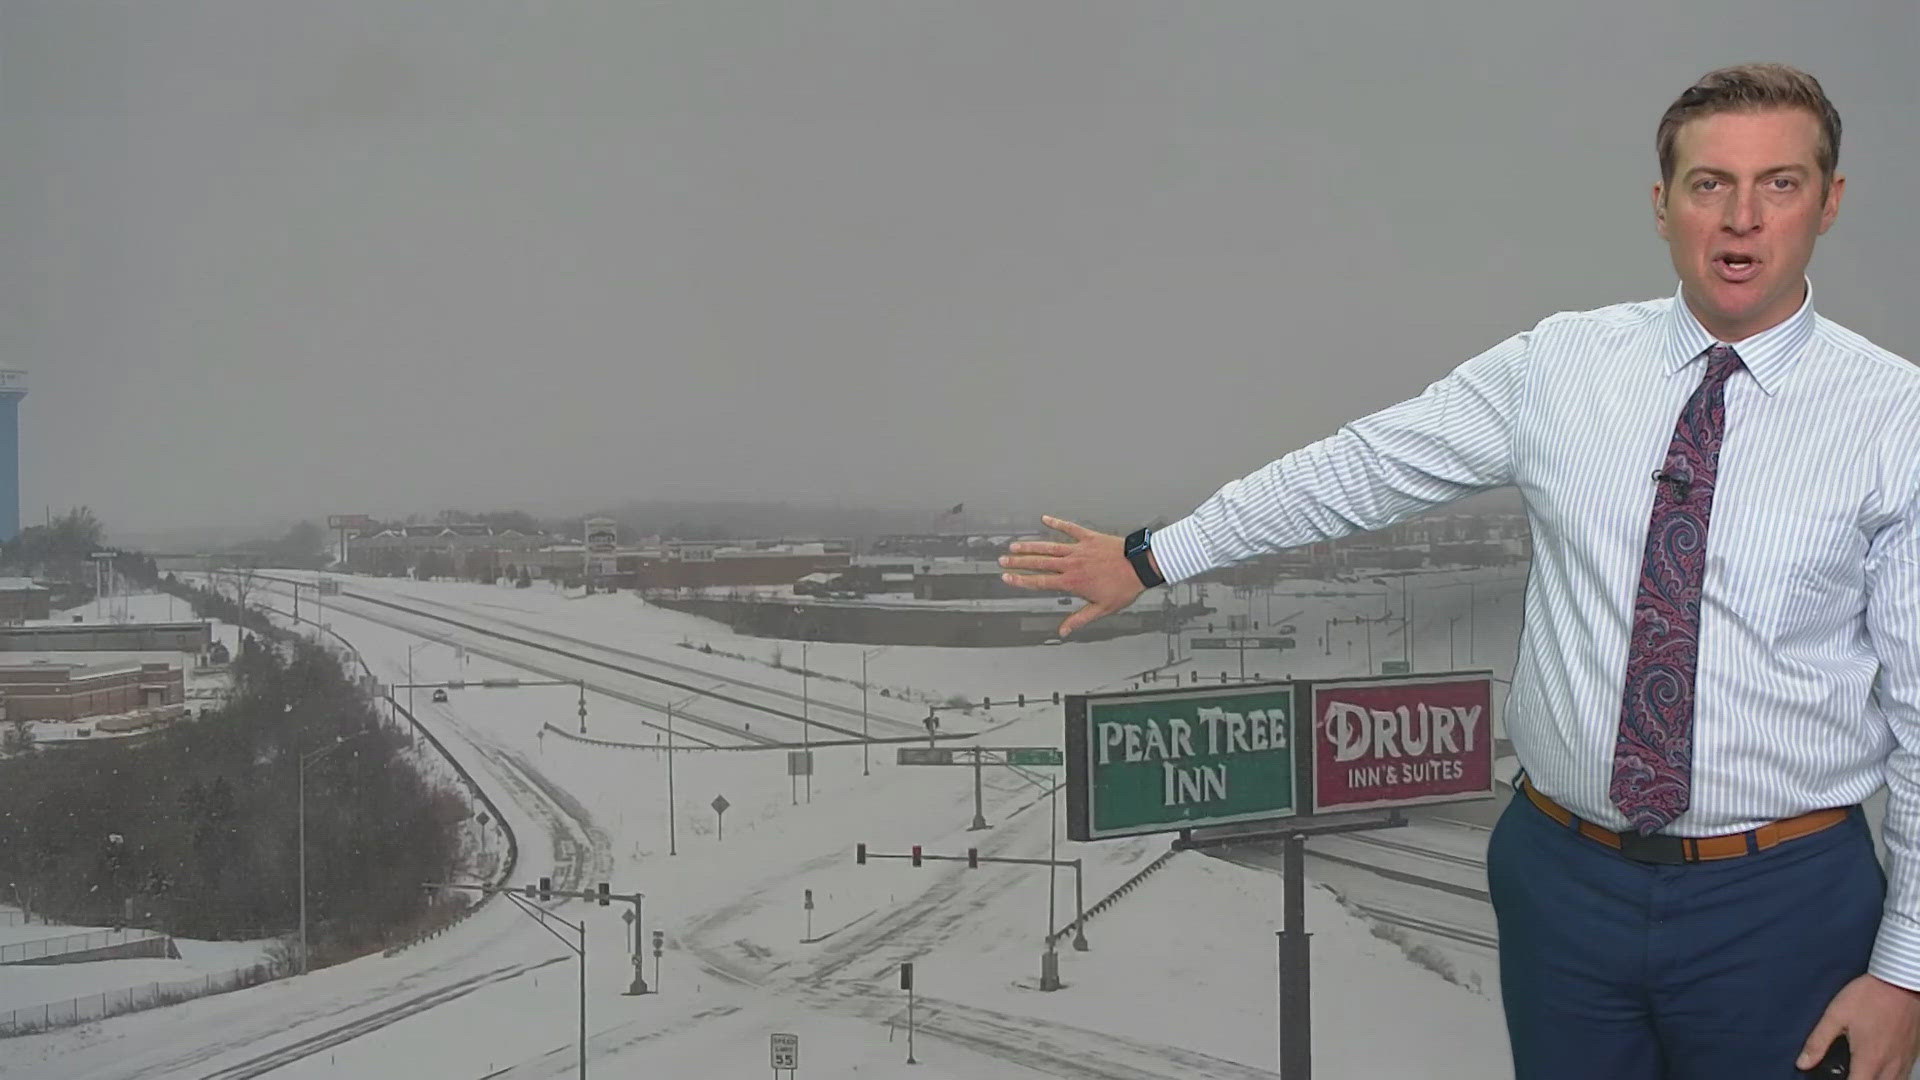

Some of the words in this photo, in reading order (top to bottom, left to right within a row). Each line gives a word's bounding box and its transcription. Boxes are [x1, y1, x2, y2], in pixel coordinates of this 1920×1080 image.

[1098, 718, 1196, 765] PEAR
[1197, 706, 1287, 755] TREE
[1317, 701, 1482, 762] DRURY
[1163, 760, 1227, 806] INN
[1348, 766, 1380, 788] INN
[1386, 766, 1398, 784] &
[1401, 760, 1464, 783] SUITES
[775, 1054, 793, 1066] 55
